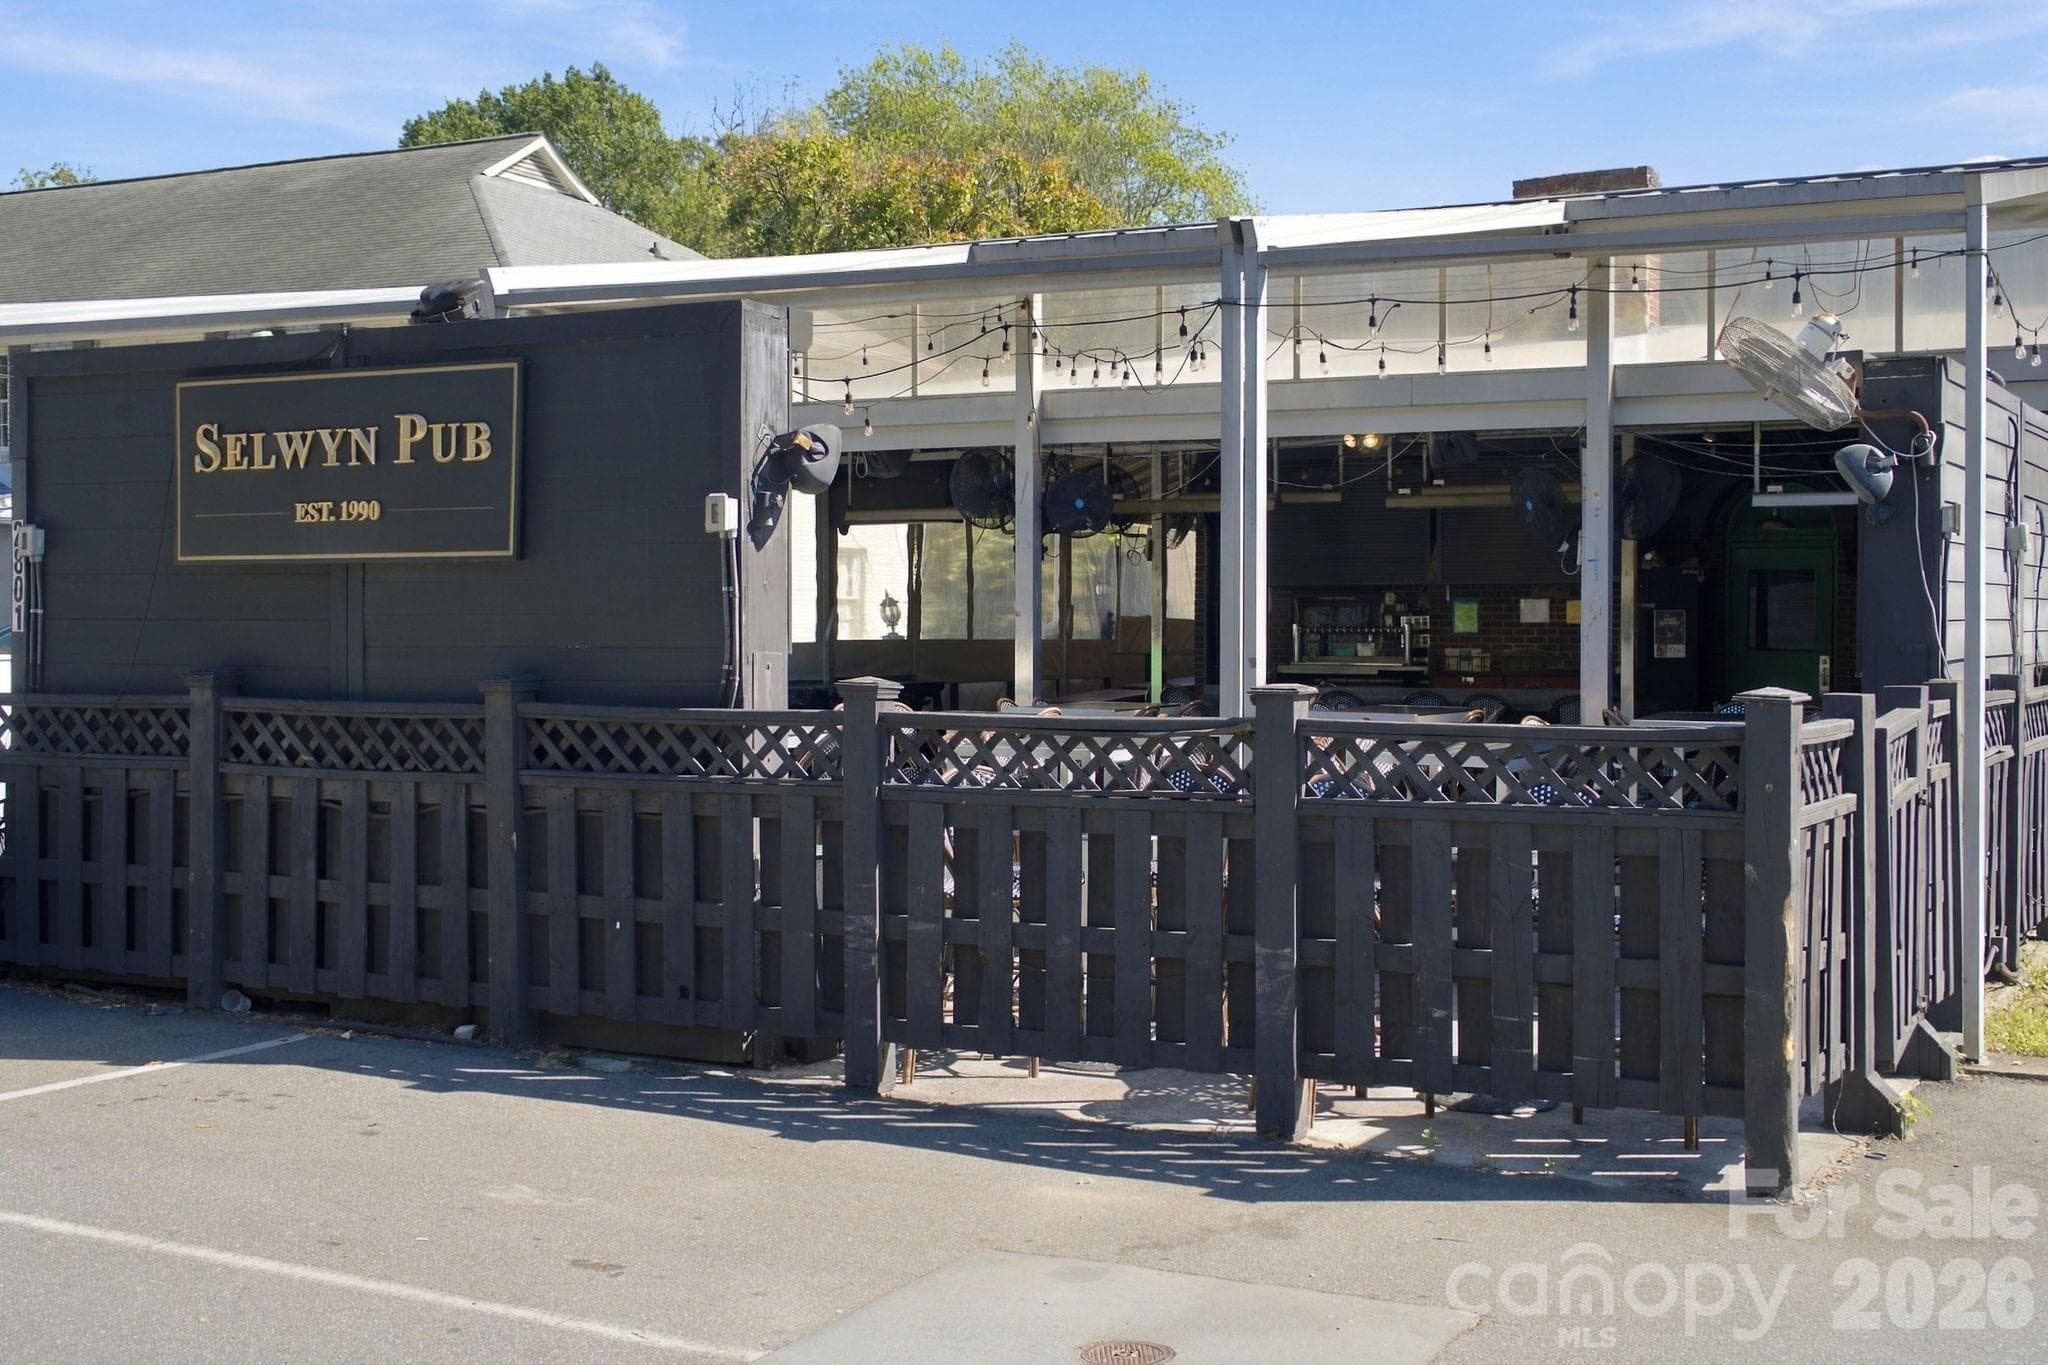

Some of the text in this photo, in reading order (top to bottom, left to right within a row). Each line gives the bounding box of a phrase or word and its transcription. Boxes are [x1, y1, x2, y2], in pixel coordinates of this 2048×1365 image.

[194, 413, 493, 474] SELWYN PUB
[294, 500, 381, 523] EST. 1990
